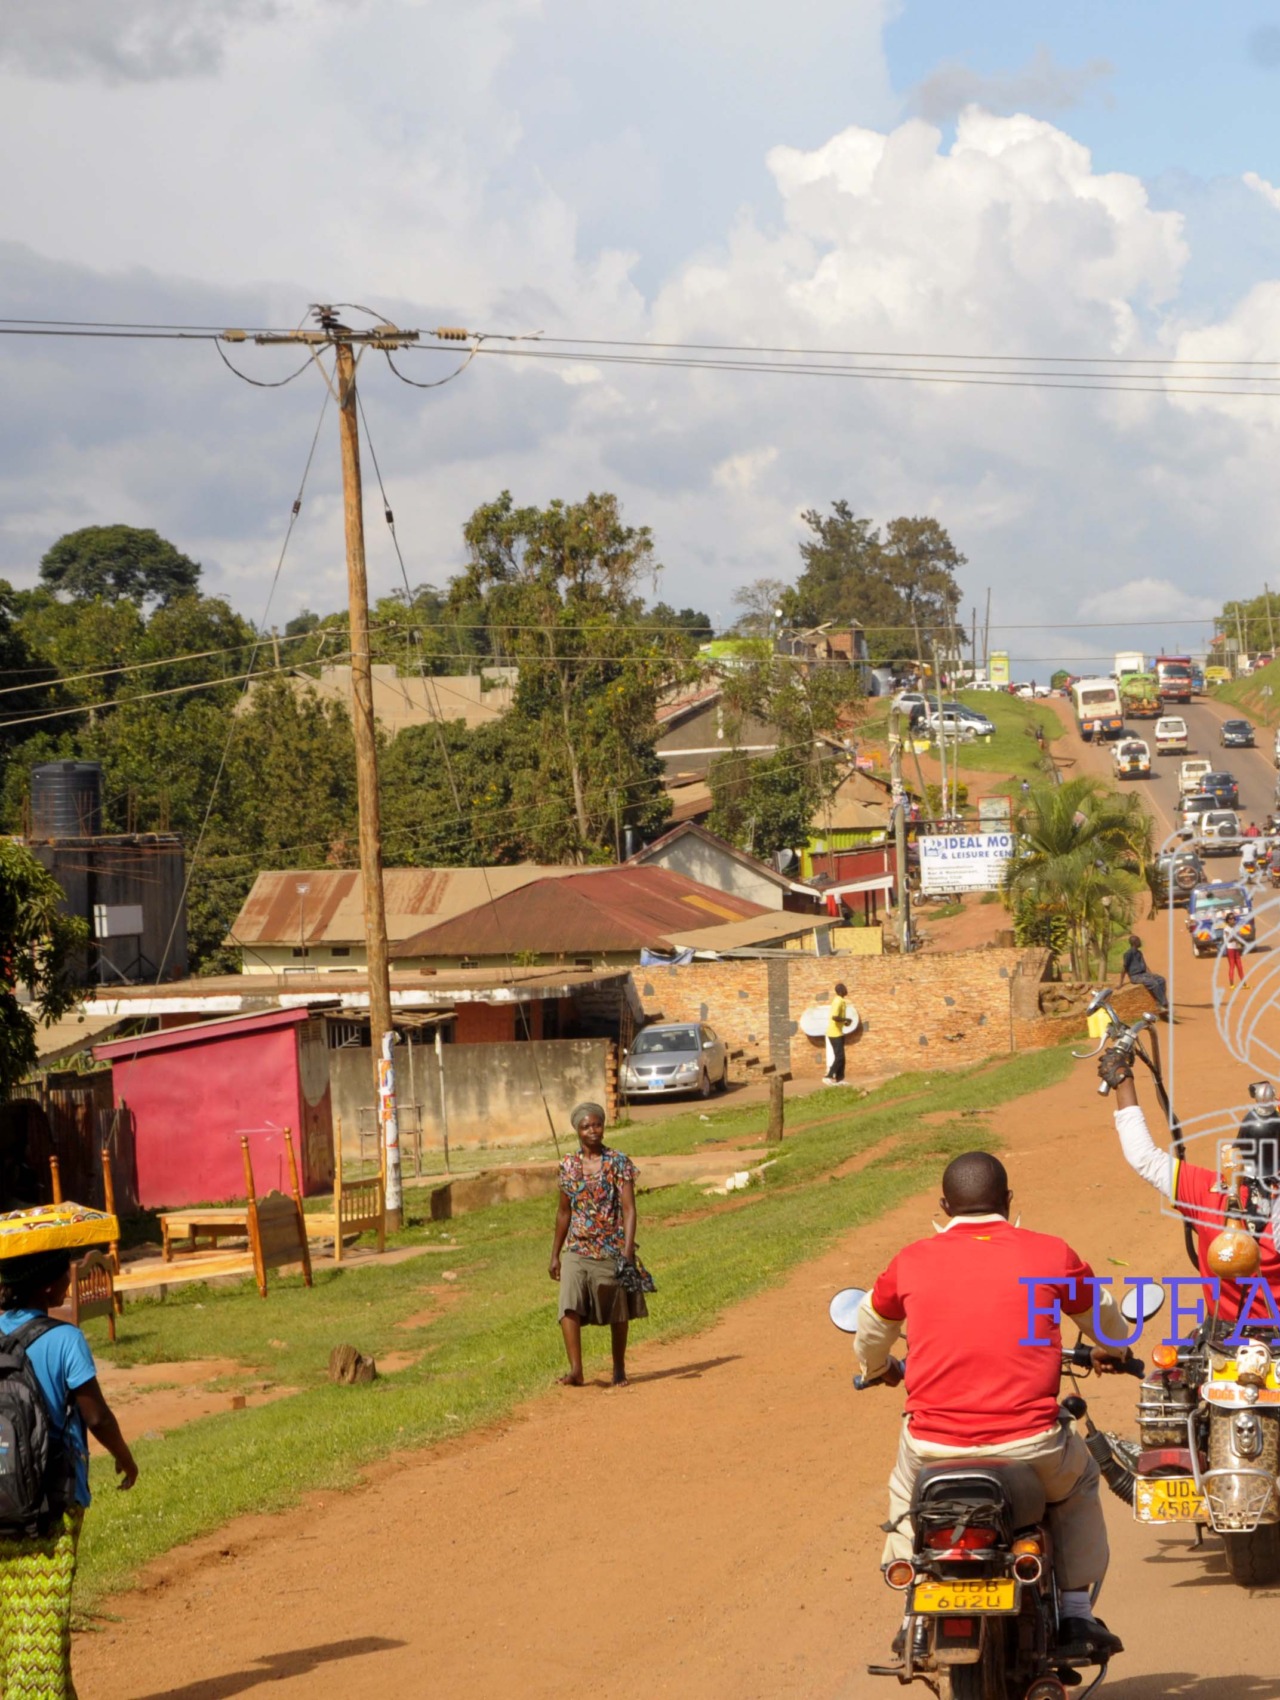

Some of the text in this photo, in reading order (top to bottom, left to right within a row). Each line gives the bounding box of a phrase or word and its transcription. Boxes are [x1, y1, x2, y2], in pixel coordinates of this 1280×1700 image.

[944, 836, 982, 850] IDEAL
[941, 849, 1014, 860] & LEISURE CEN
